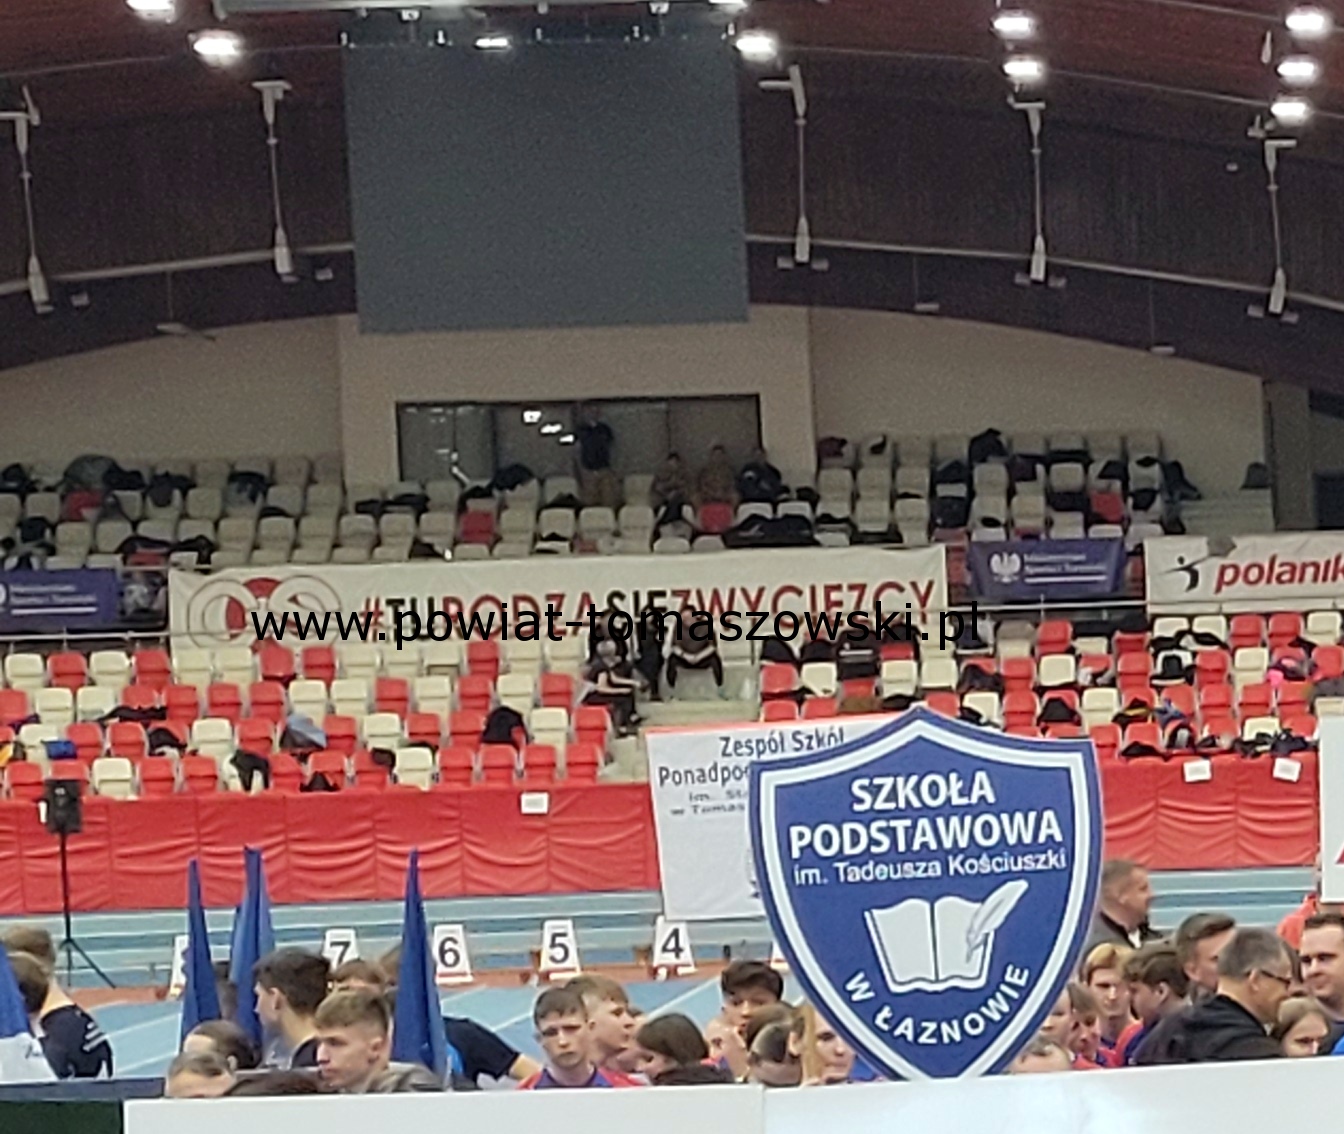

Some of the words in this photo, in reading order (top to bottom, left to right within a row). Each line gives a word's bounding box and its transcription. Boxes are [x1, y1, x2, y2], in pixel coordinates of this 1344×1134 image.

[850, 770, 997, 812] SZKOŁA
[789, 809, 1063, 859] PODSTAWOWA
[794, 863, 829, 886] im.
[833, 858, 942, 883] Tadeusza
[948, 847, 1067, 877] Kościuszki
[329, 940, 351, 966] 7
[438, 936, 461, 968] 6
[547, 932, 570, 964] 5
[660, 927, 685, 960] 4
[845, 971, 875, 1002] W
[874, 963, 1029, 1044] ŁAZNOWIE
